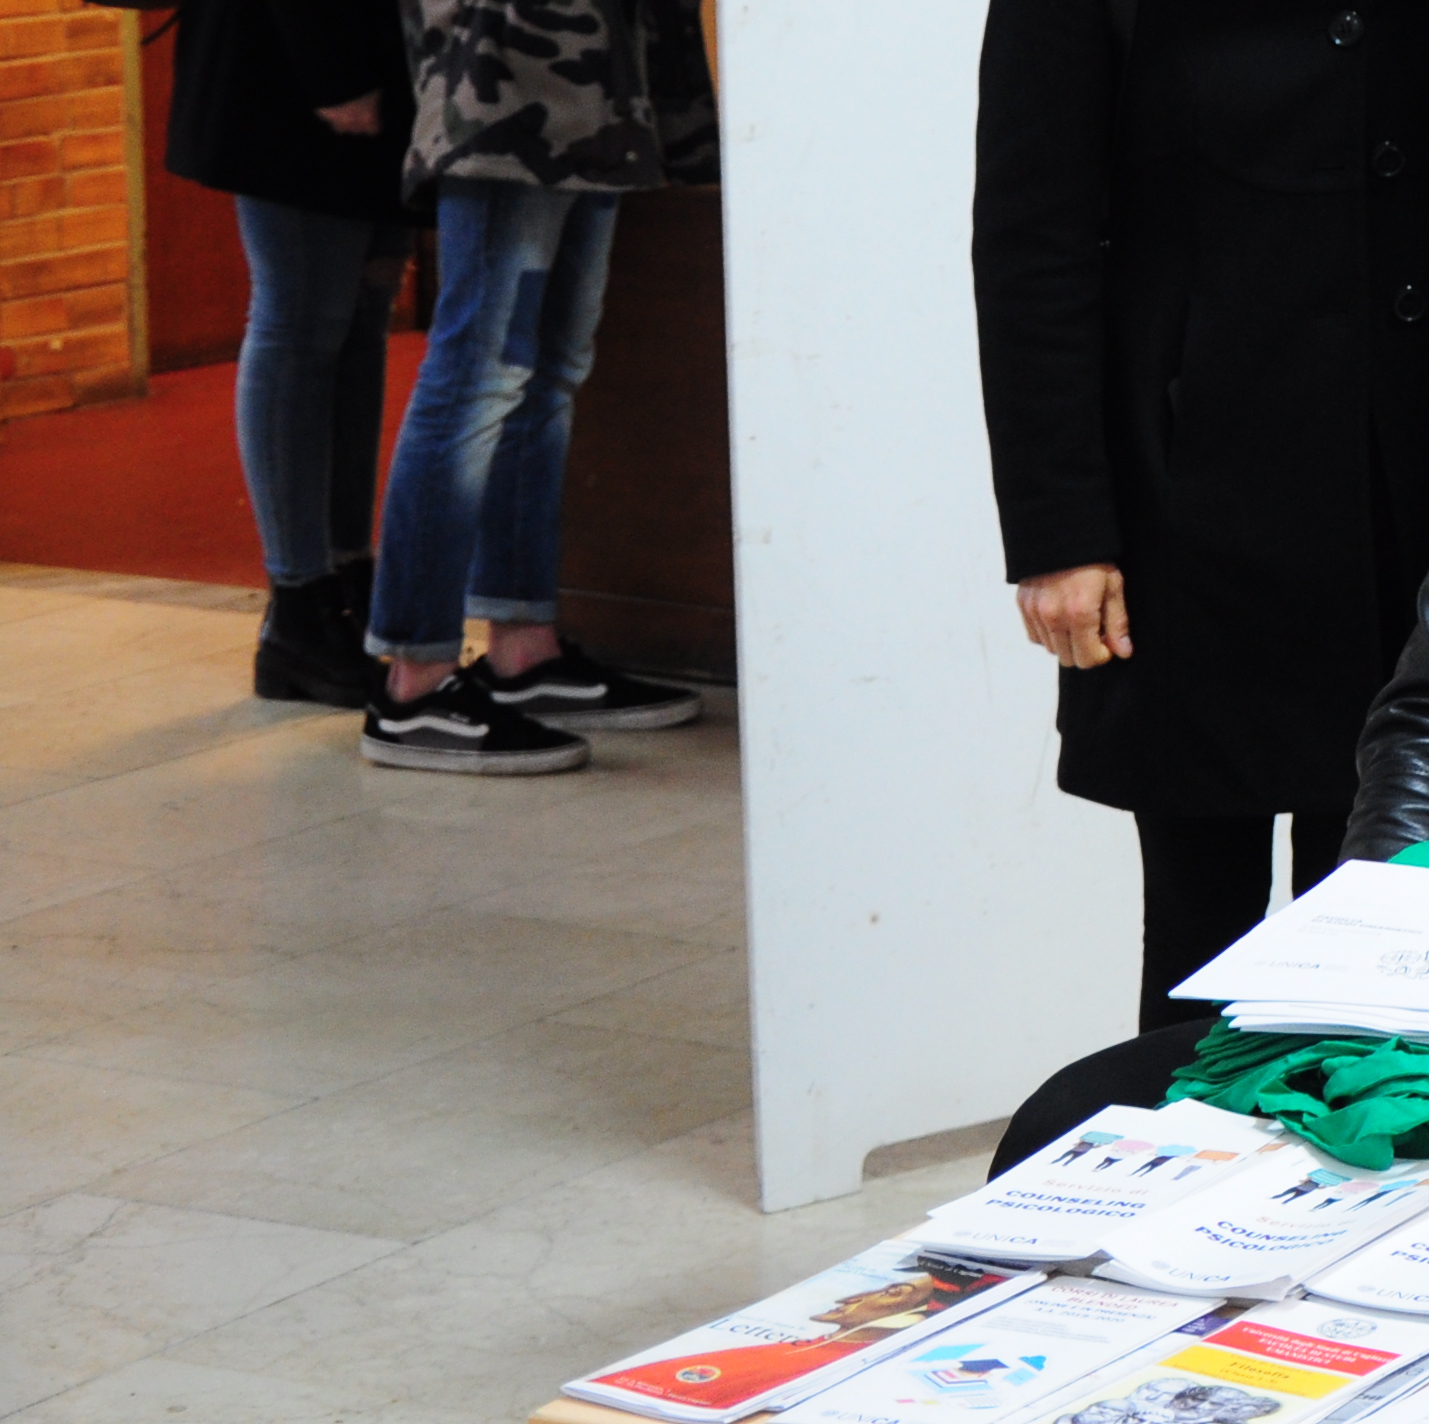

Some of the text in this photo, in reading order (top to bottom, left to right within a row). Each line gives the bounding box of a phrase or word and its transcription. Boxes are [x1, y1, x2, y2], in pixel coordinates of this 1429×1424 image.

[986, 1199, 1137, 1218] PSICOLOGICO
[1005, 1190, 1147, 1209] COUNSELING
[972, 1231, 1039, 1245] UNICA
[1194, 1226, 1335, 1251] PSICOLOGICO
[1217, 1220, 1349, 1241] COUNSELING
